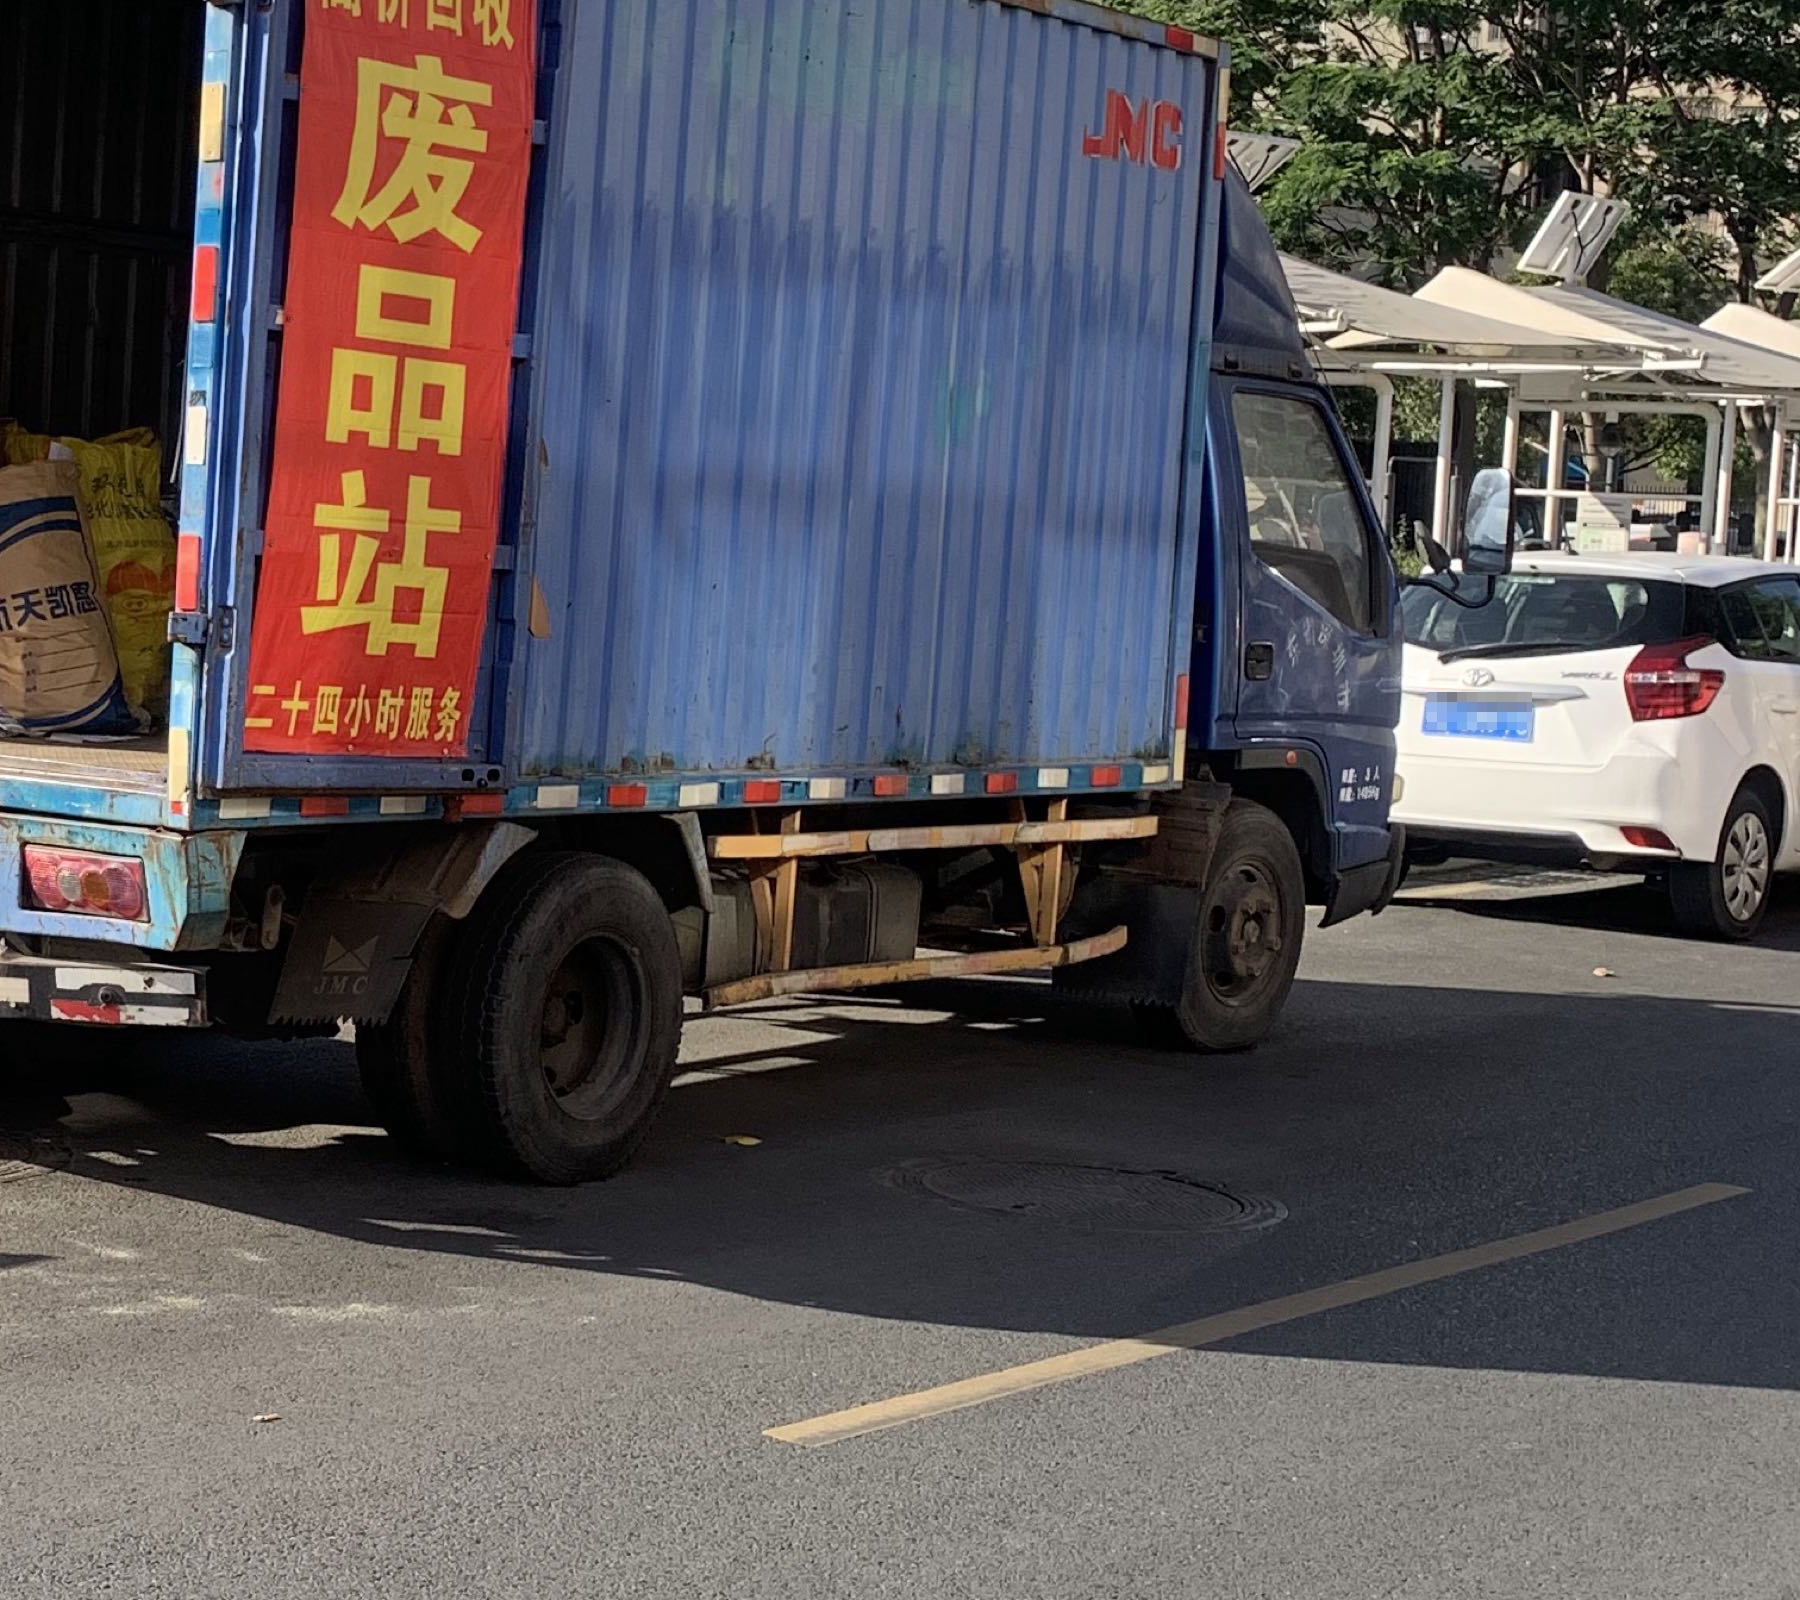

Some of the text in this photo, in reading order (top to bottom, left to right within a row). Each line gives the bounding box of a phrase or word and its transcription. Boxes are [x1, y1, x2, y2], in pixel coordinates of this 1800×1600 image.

[300, 53, 493, 658] 废品站
[244, 679, 463, 743] 二十四小时服务
